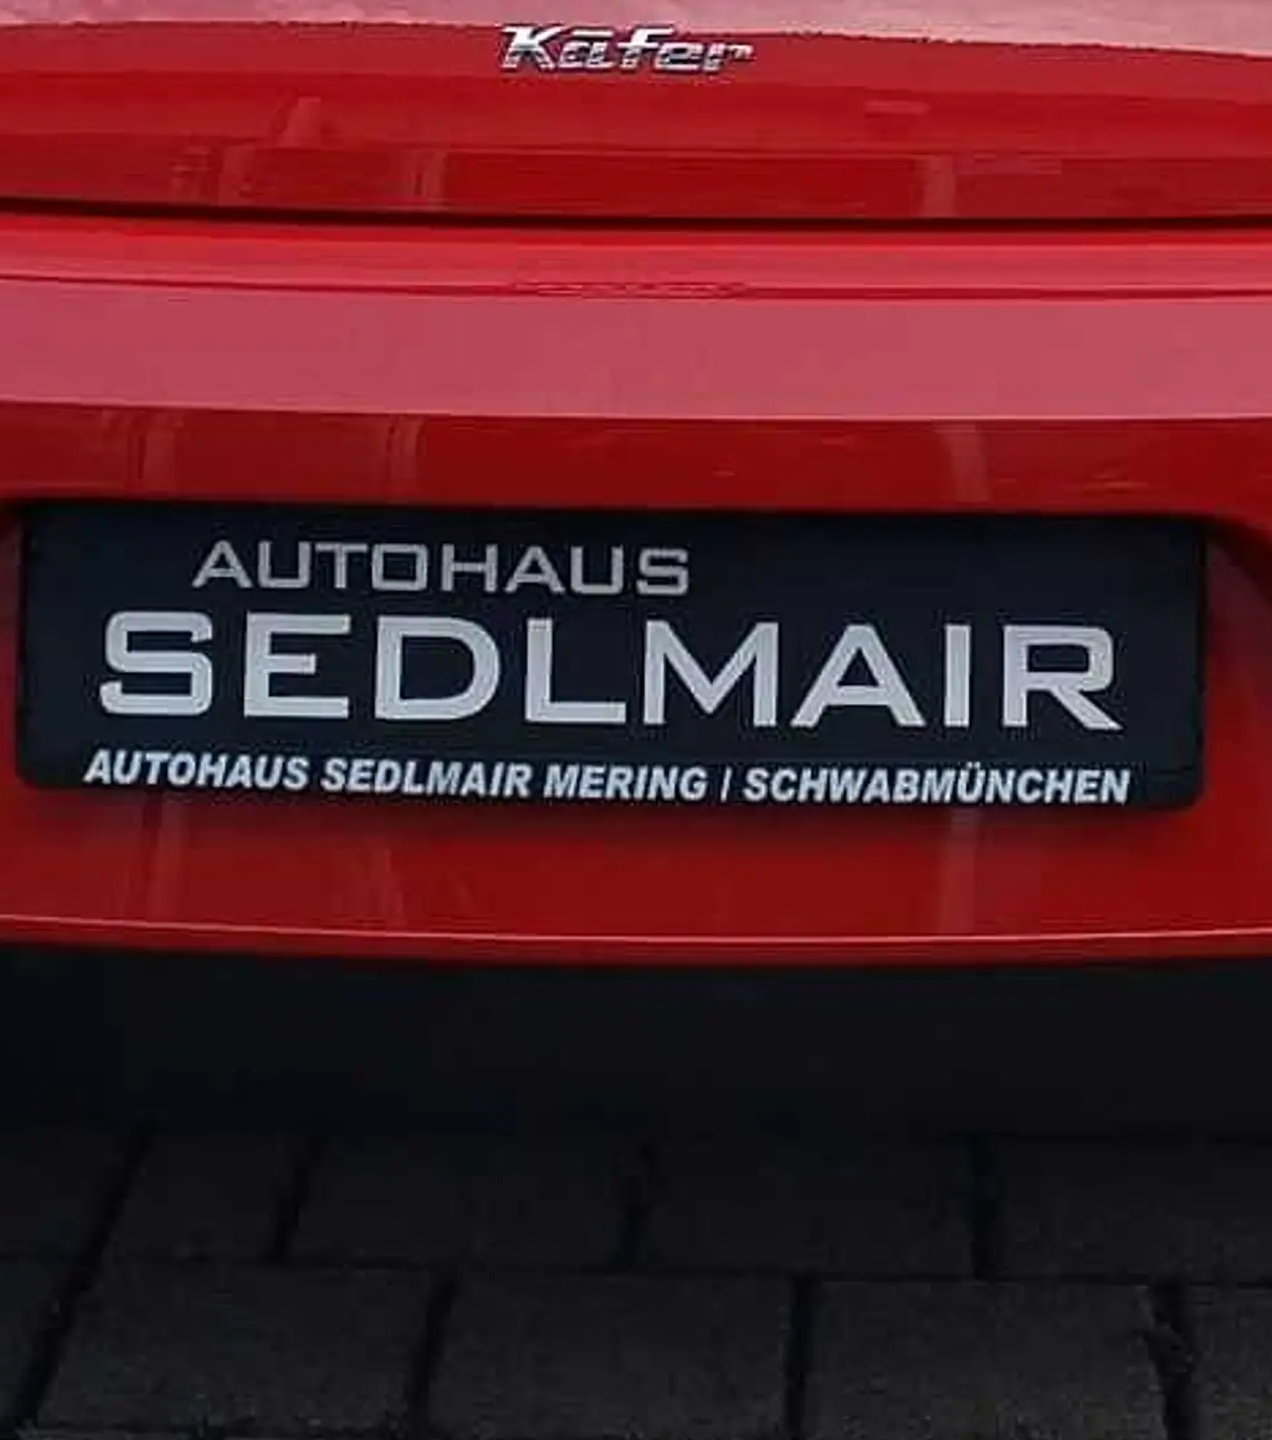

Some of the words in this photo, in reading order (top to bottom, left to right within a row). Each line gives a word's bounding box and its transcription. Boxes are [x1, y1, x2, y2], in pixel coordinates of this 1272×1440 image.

[191, 539, 690, 597] AUTOHAUS
[98, 610, 1124, 731] SEDLMAIR
[83, 749, 310, 792] AUTOHAUS
[320, 757, 532, 800] SEDLMAIR
[543, 763, 708, 804] MERING
[742, 762, 1131, 806] SCHWABMÜNCHEN
